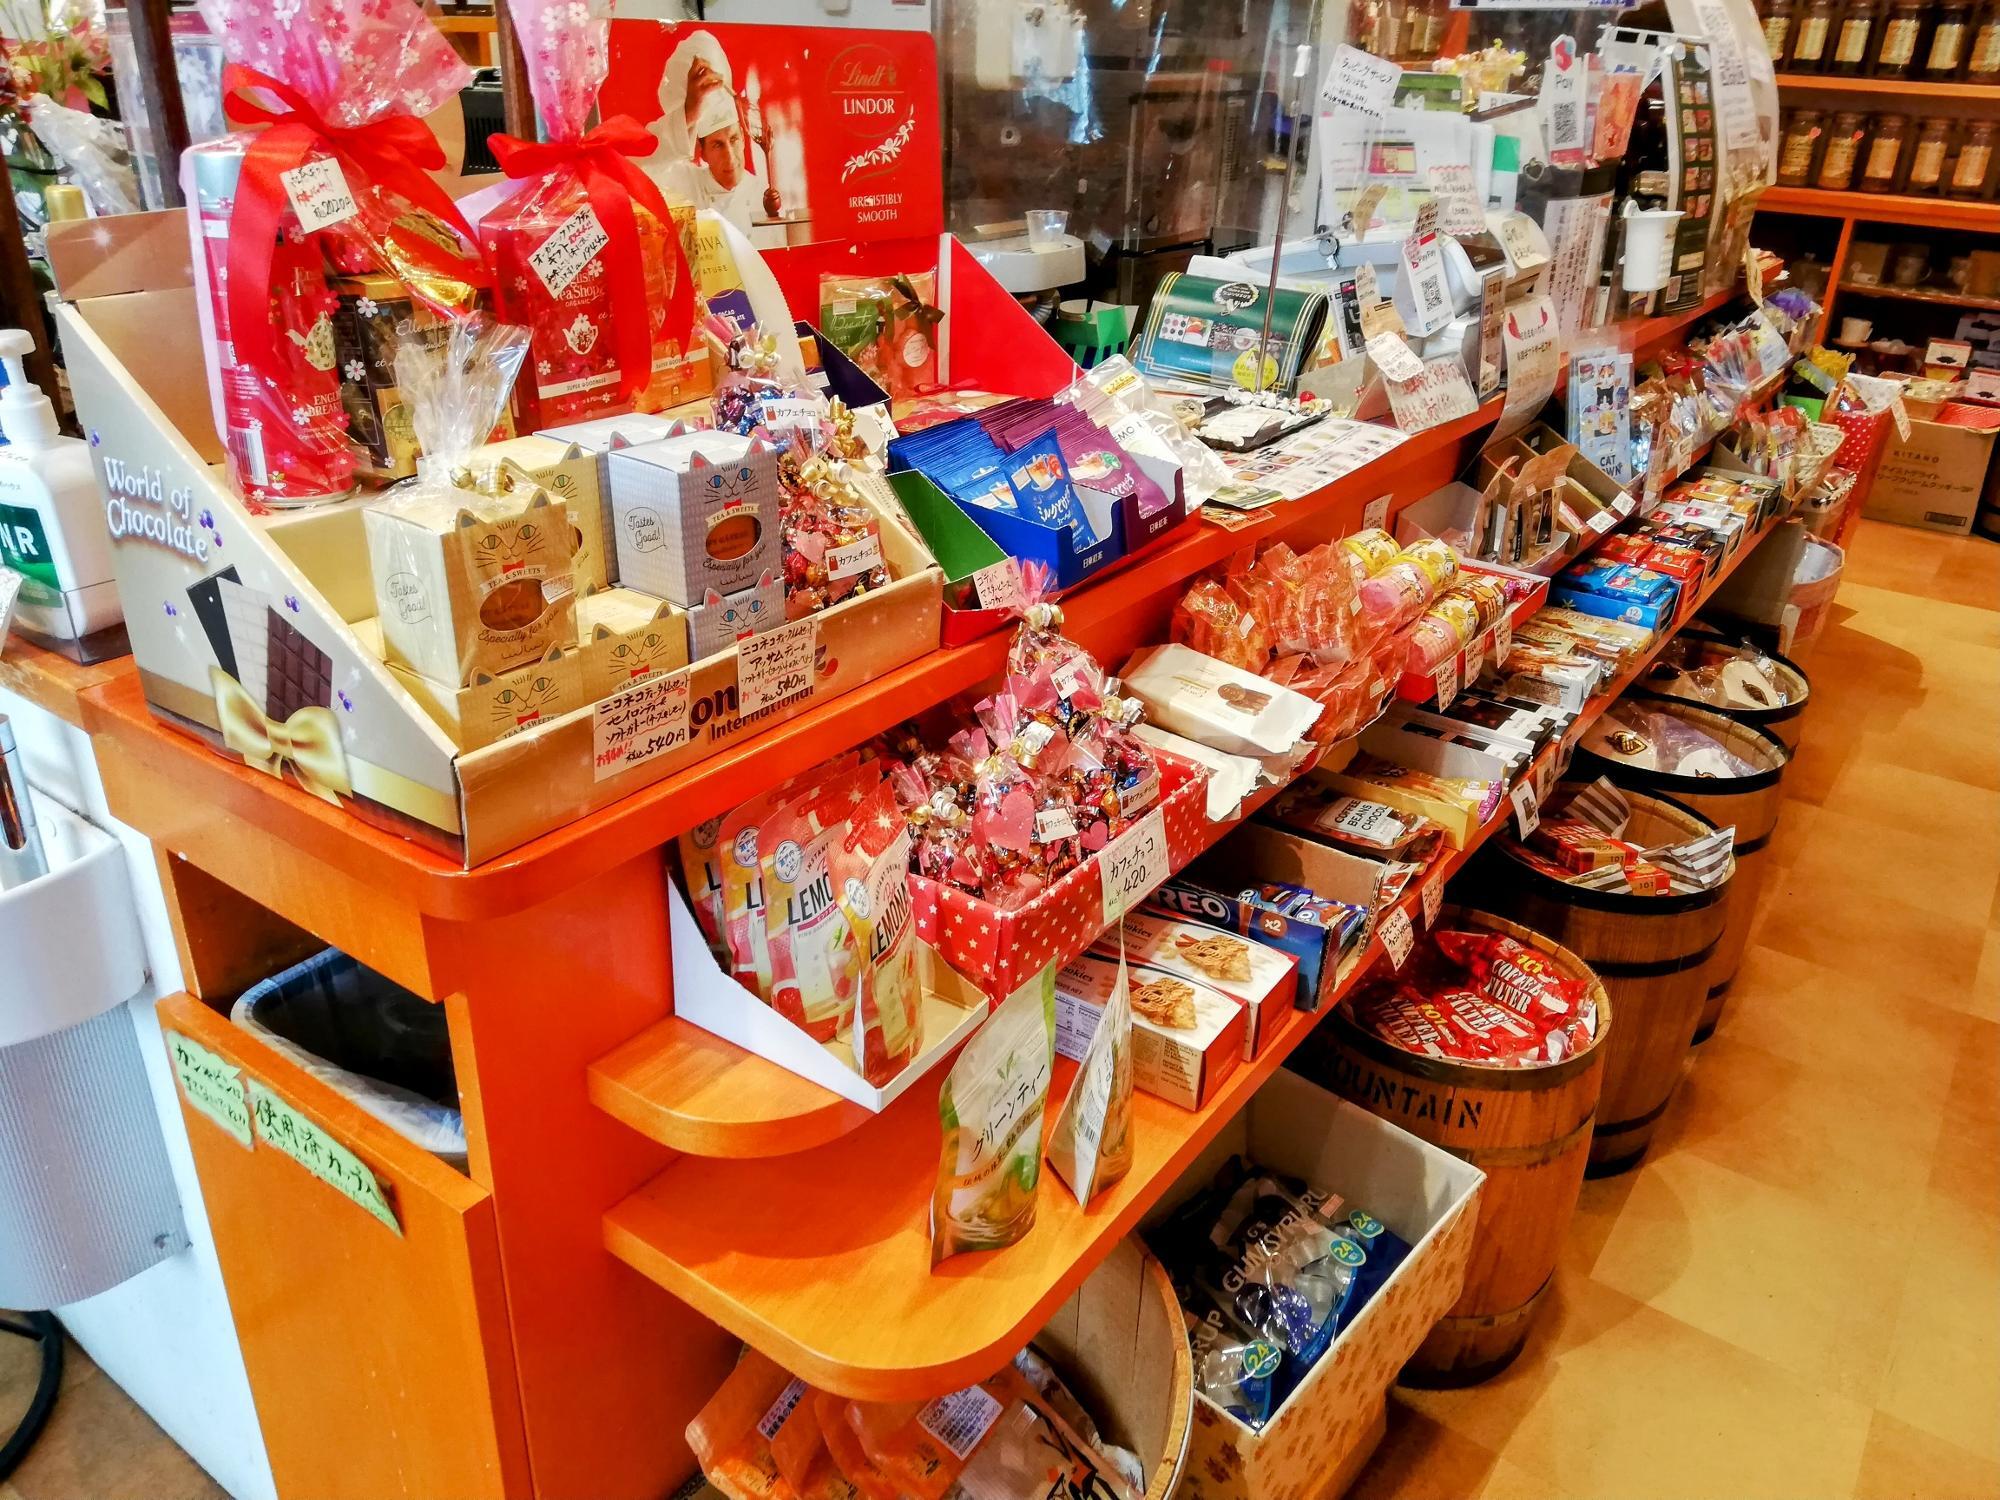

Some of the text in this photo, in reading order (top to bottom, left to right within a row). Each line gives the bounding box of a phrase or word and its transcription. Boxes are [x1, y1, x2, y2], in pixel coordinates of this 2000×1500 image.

[843, 98, 895, 115] LINDOR
[848, 193, 903, 209] IRRESISTIBLY
[857, 209, 898, 223] SMOOTH
[702, 264, 728, 275] ATURE
[313, 389, 342, 405] ENGLI
[1600, 454, 1616, 467] CAT
[104, 456, 193, 519] World of
[107, 496, 209, 563] Chocolate
[477, 630, 527, 647] Especially
[1335, 799, 1362, 824] COFFEE
[1347, 804, 1373, 827] BEANS
[1110, 837, 1155, 883] カフェチョコ
[1154, 887, 1229, 923] REO
[1516, 954, 1544, 974] 101
[1484, 978, 1533, 1014] FILTER
[1420, 1002, 1449, 1026] 101
[1332, 1054, 1483, 1130] OUNTAIN
[972, 1064, 1046, 1163] グリーンティー
[1334, 1242, 1352, 1258] 24
[1192, 1309, 1225, 1352] RUP
[1248, 1344, 1270, 1369] 24
